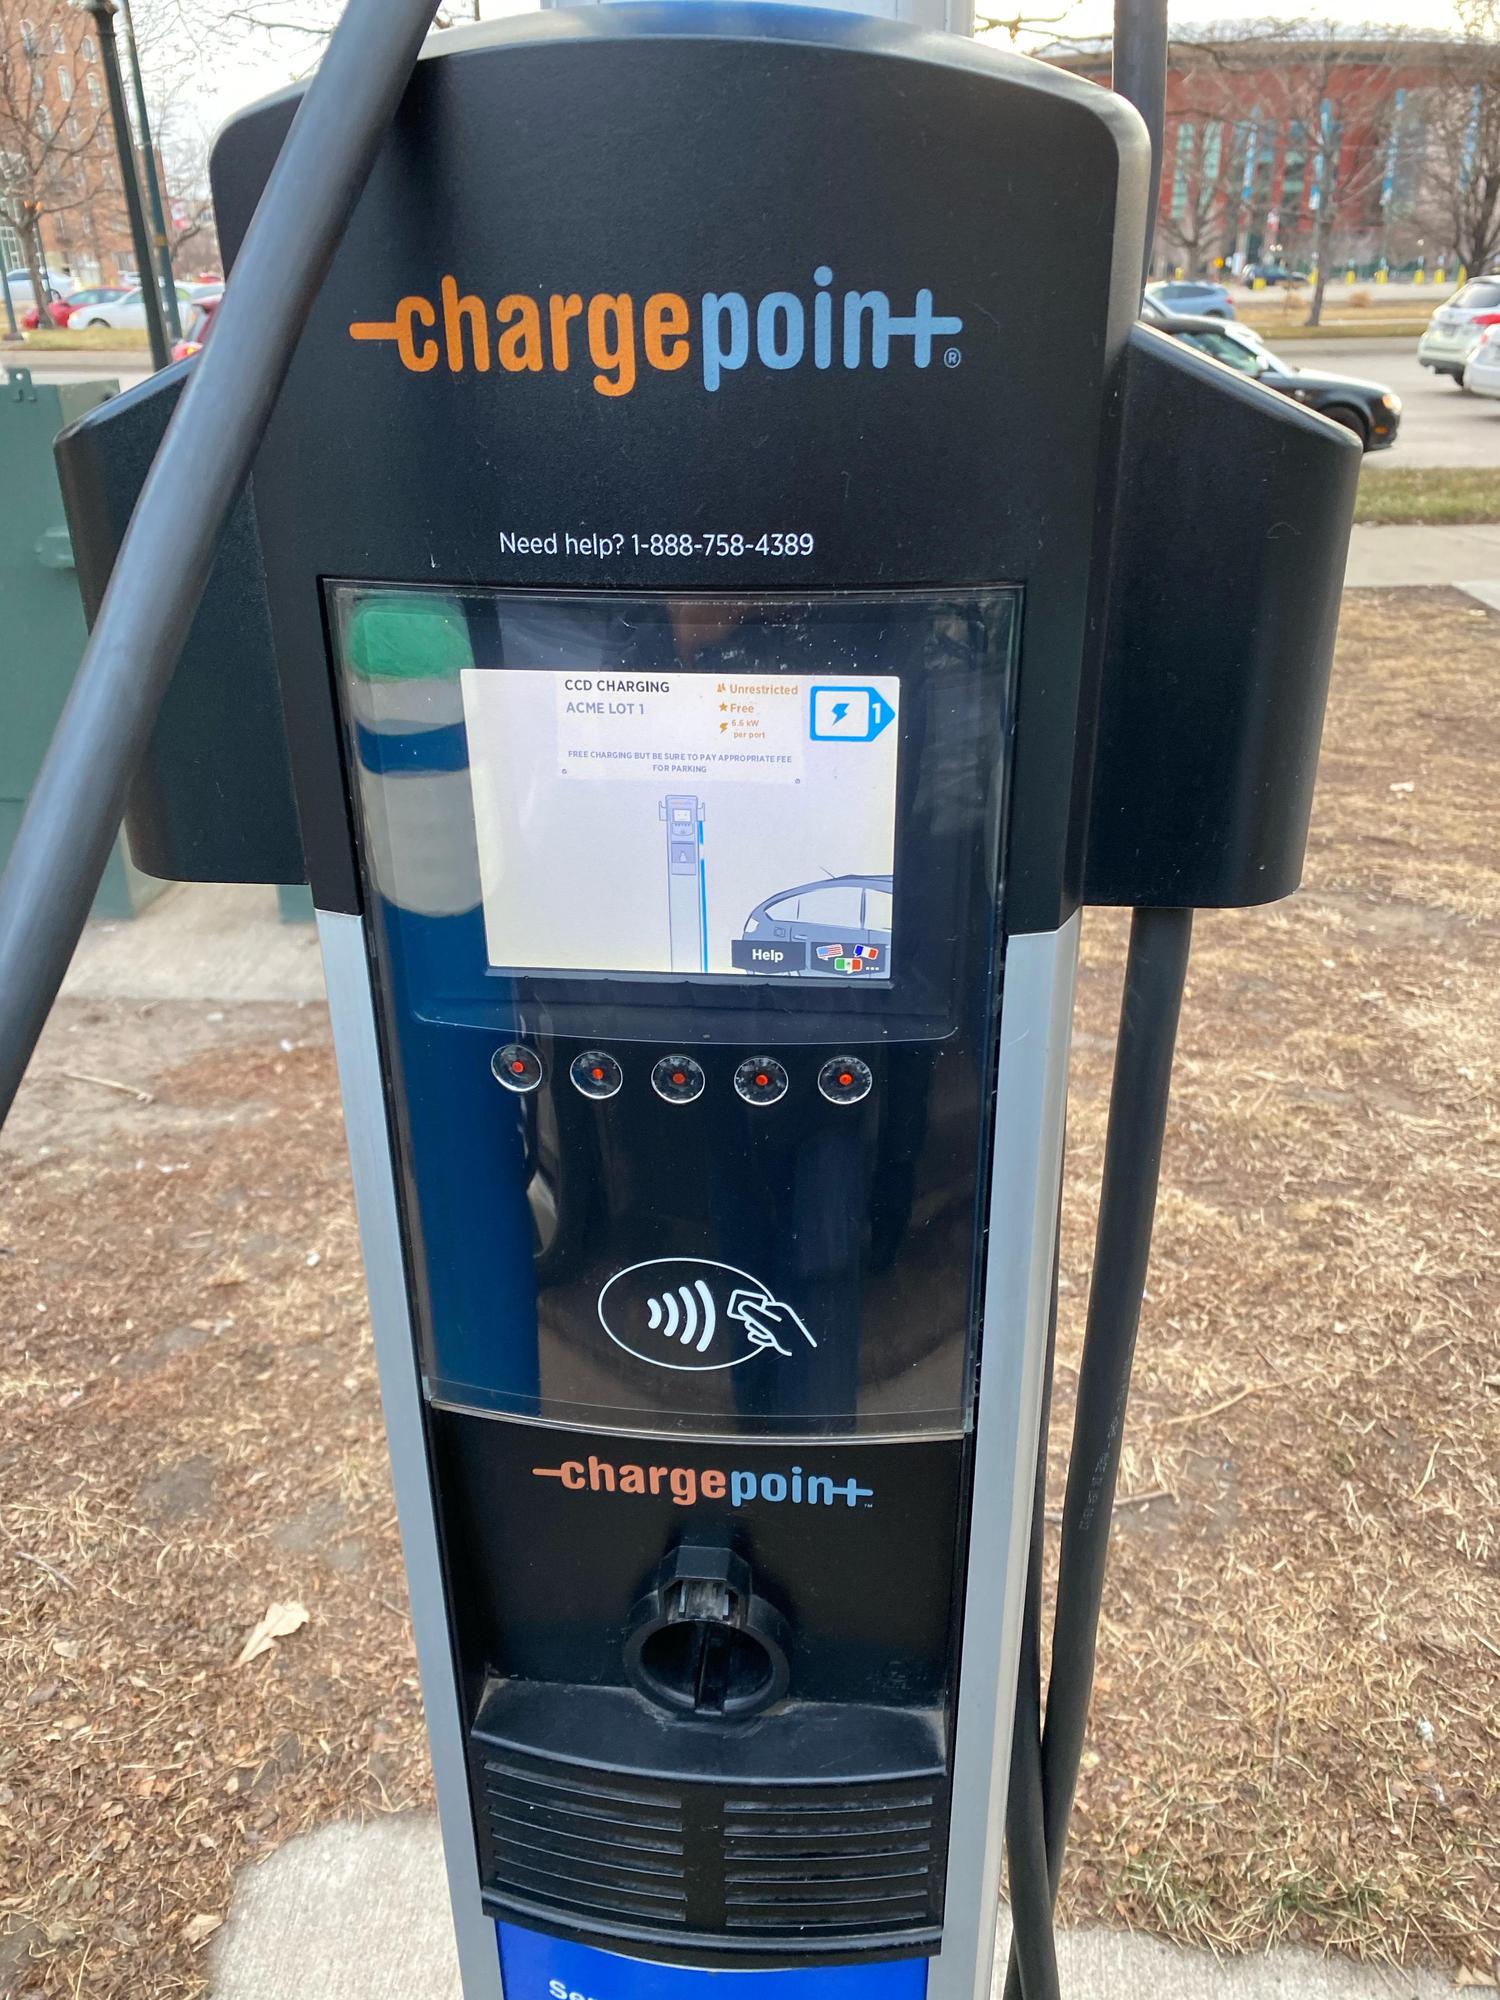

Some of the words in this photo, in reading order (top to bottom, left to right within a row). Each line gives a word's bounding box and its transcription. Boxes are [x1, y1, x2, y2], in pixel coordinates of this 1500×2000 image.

[499, 532, 557, 554] Need
[565, 532, 624, 559] help?
[631, 533, 814, 556] 1-888-758-4389
[564, 679, 593, 691] CCD
[596, 680, 670, 693] CHARGING
[729, 683, 799, 695] Unrestricted
[566, 702, 605, 714] ACME
[608, 703, 634, 715] LOT
[638, 703, 645, 715] 1
[730, 703, 754, 713] Free
[871, 702, 882, 724] 1
[748, 731, 765, 739] port
[568, 750, 589, 758] FREE
[590, 751, 633, 760] CHARGING
[634, 752, 650, 760] BUT
[652, 752, 663, 760] BE
[664, 752, 686, 761] SURE
[687, 753, 698, 761] TO
[700, 753, 717, 761] PAY
[718, 754, 775, 763] APPROPRIATE
[776, 755, 792, 763] FEE
[652, 764, 670, 772] FOR
[671, 765, 707, 773] PARKING
[751, 949, 784, 962] Help
